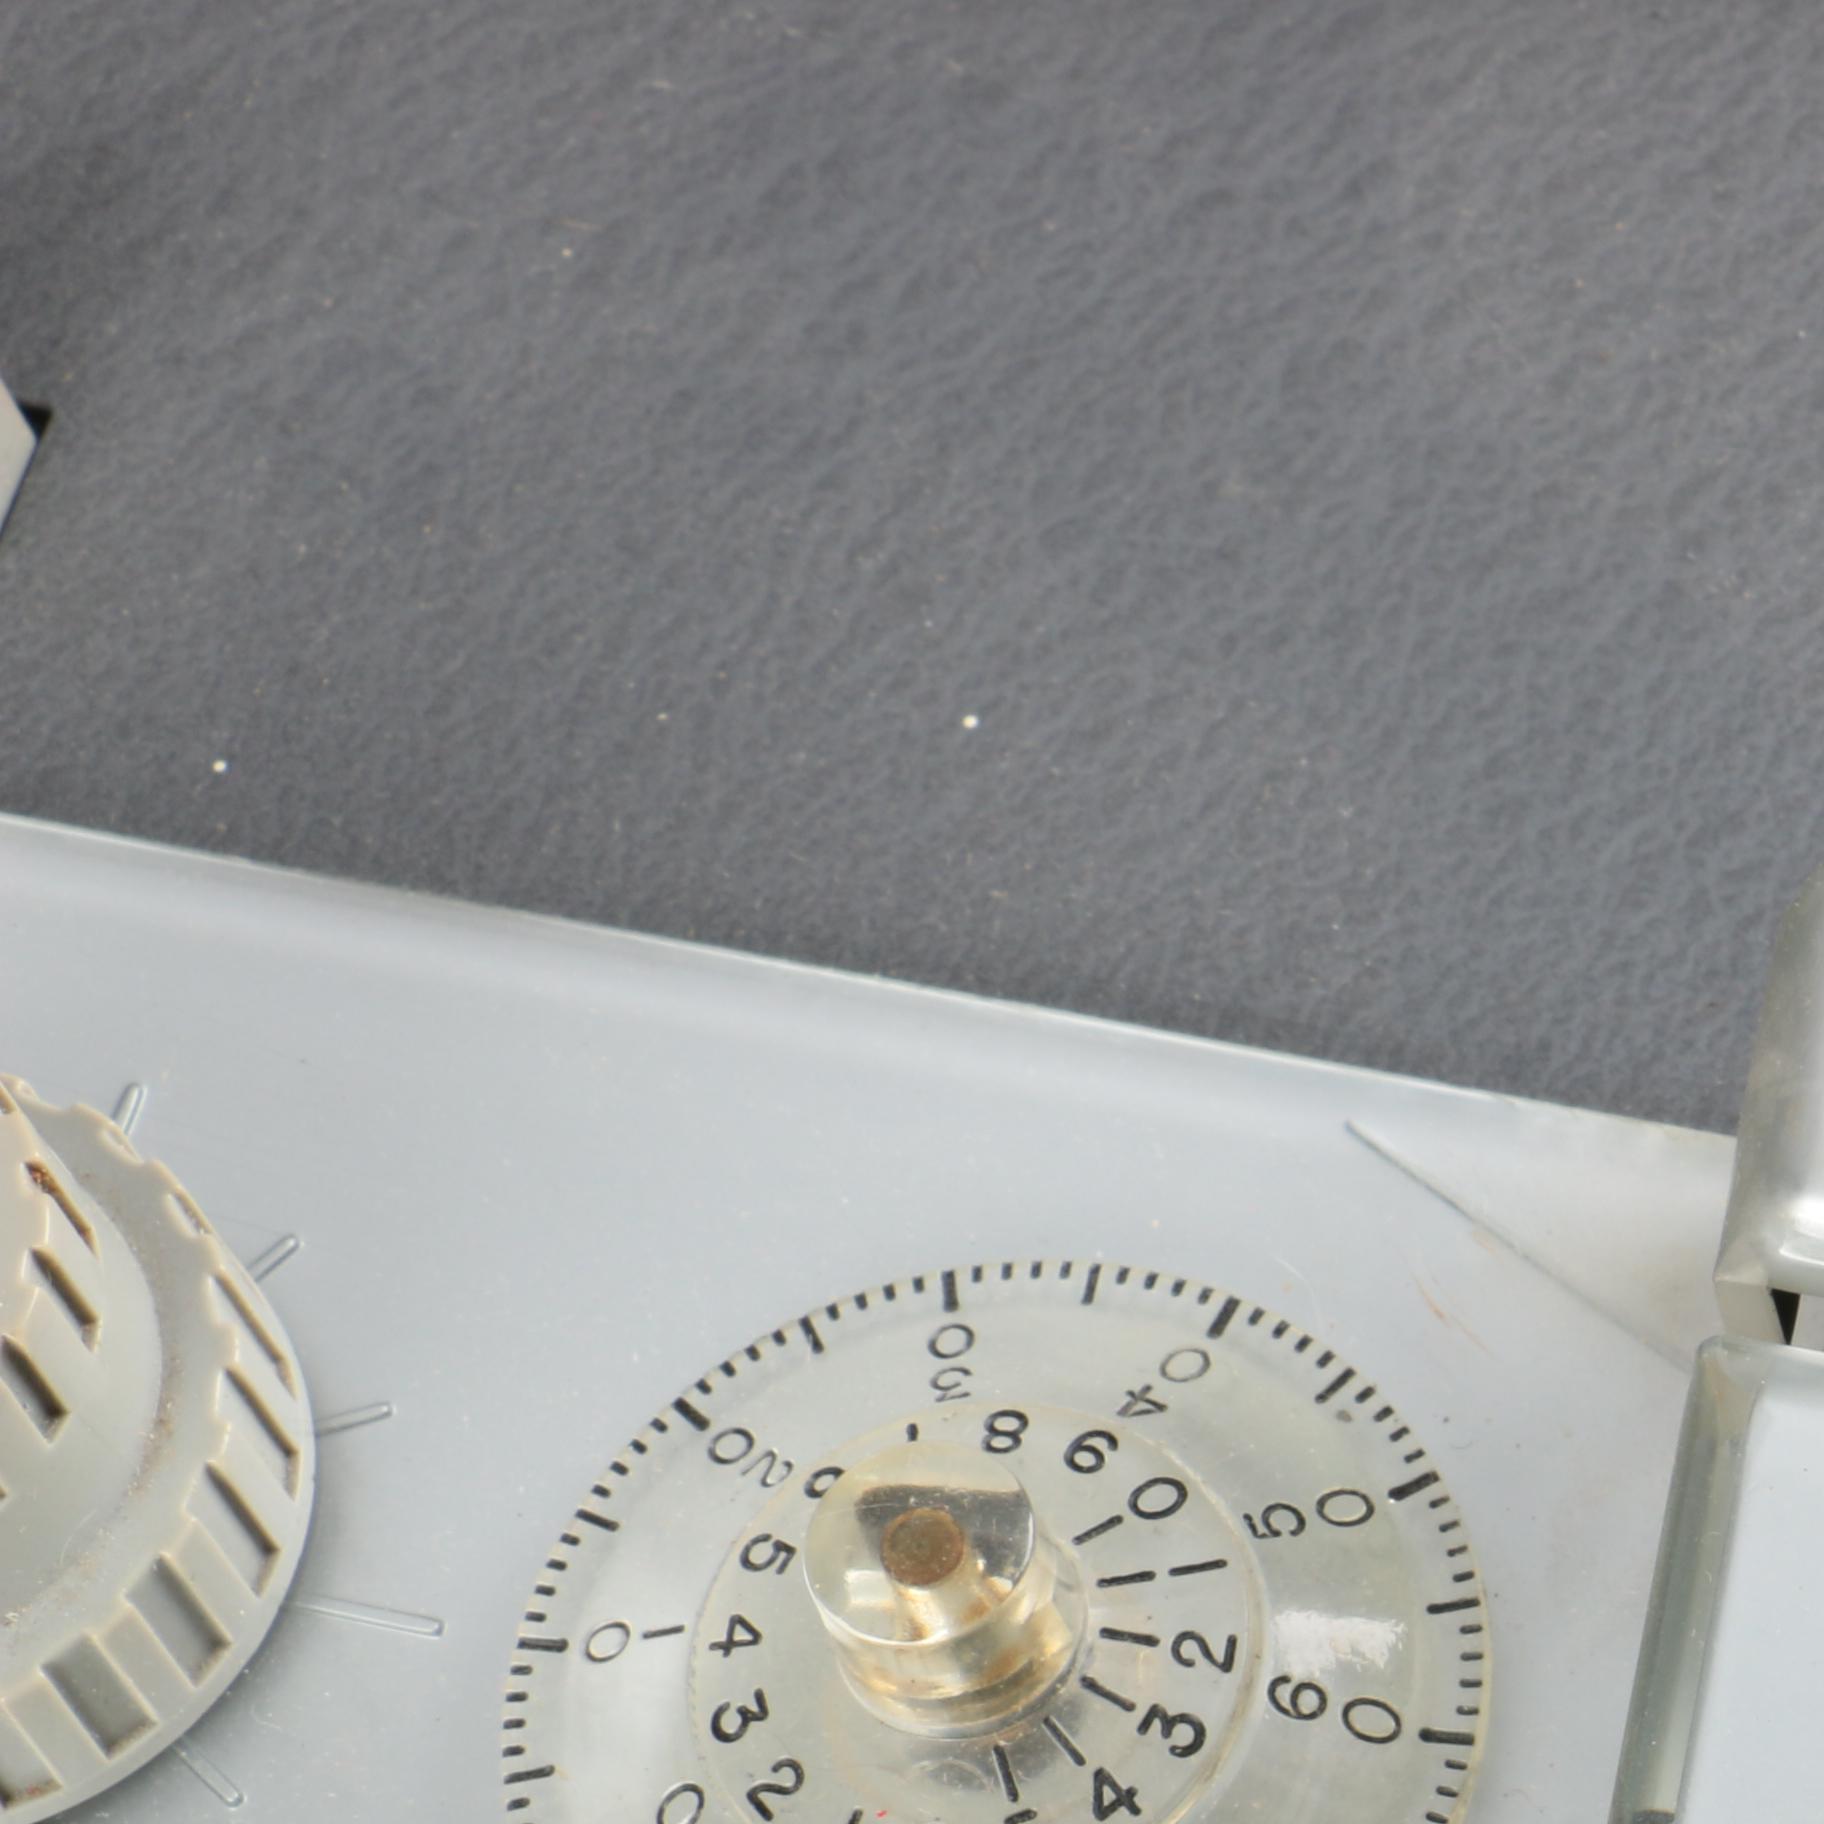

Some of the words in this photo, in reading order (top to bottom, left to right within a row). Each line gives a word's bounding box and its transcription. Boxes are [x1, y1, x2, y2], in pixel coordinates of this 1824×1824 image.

[981, 1408, 1030, 1455] 8
[1127, 1476, 1189, 1521] 0
[739, 1532, 797, 1576] 5
[708, 1614, 763, 1659] 4
[1170, 1630, 1238, 1674] 2
[710, 1687, 770, 1744] 3
[1137, 1703, 1207, 1759] 3
[745, 1757, 806, 1823] 2
[1091, 1767, 1142, 1822] 4
